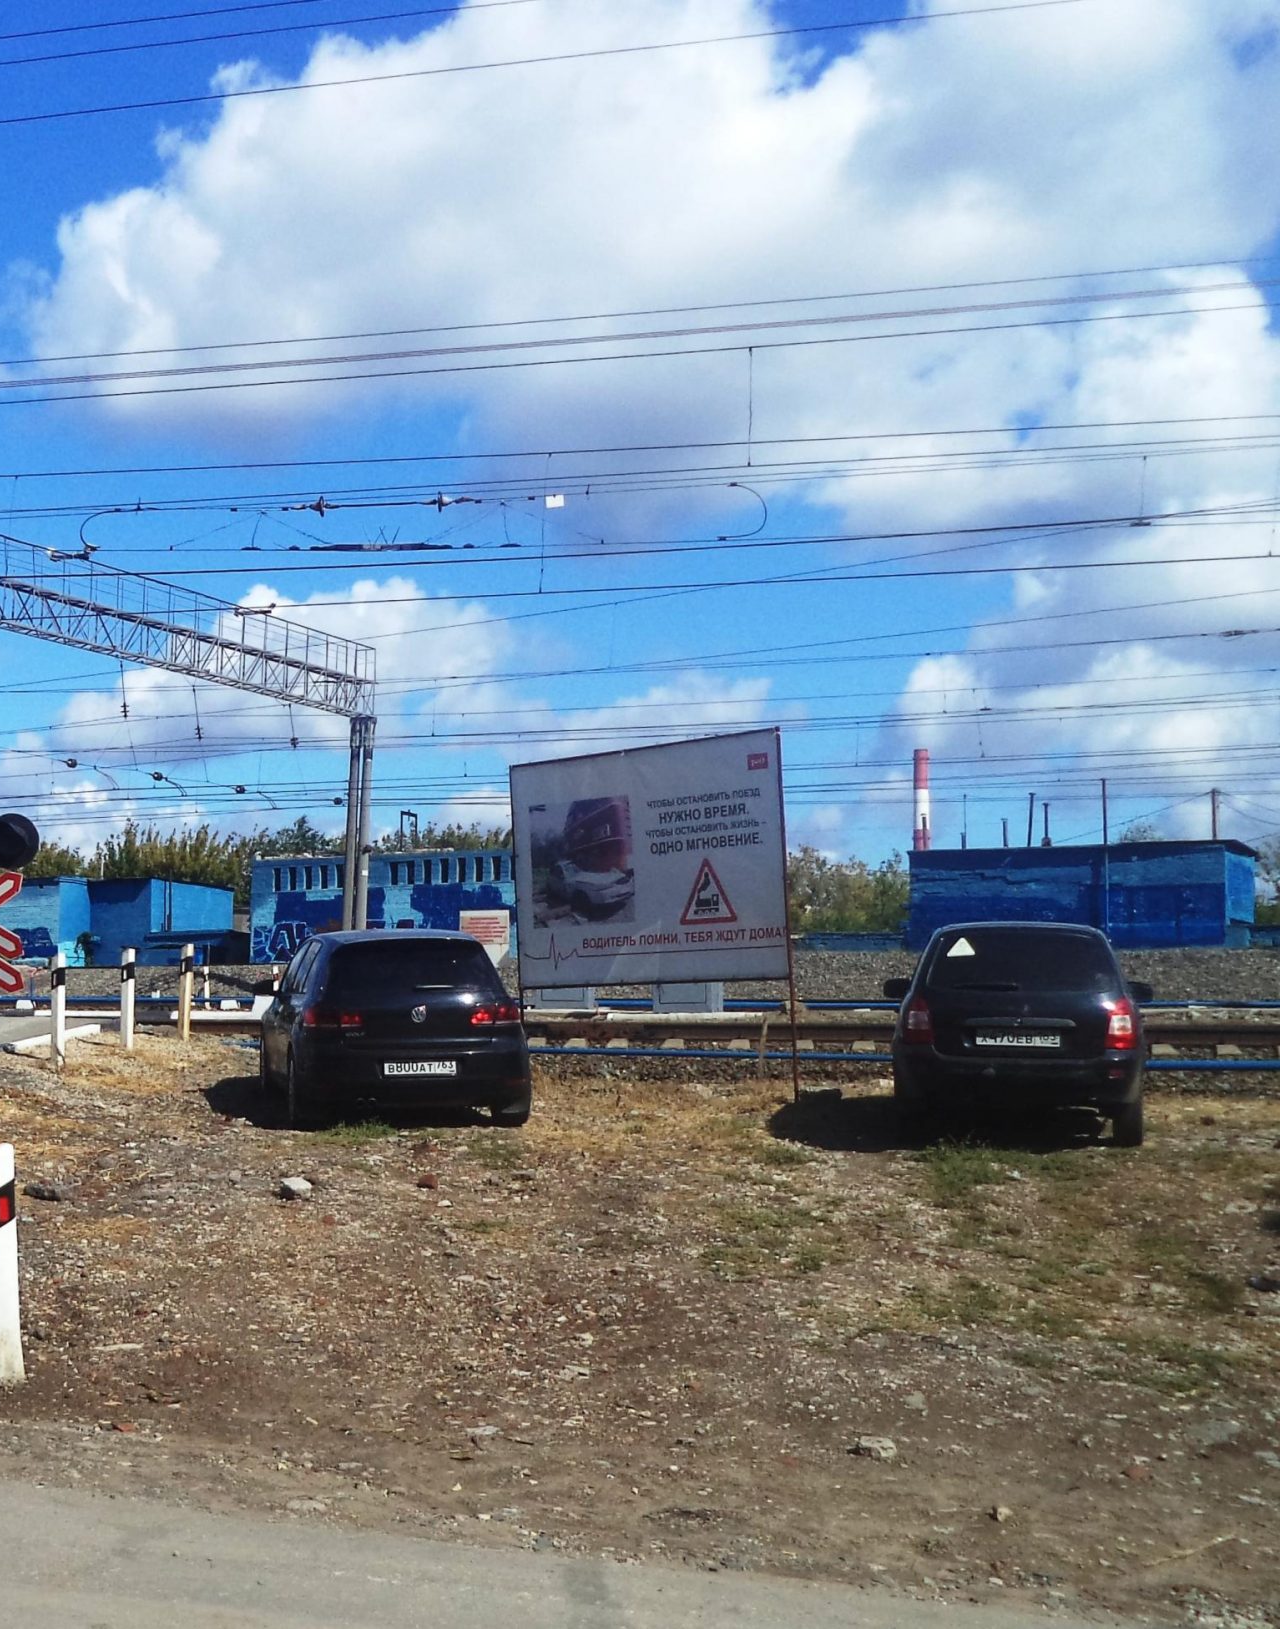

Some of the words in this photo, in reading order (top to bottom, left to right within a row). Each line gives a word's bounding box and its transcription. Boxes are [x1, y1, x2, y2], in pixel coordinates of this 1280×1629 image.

[647, 798, 675, 809] ЧТОБЫ
[676, 791, 730, 806] ОСТАНОВИТЬ
[732, 788, 760, 799] ПОЕЗД
[659, 808, 701, 824] НУЖНО
[704, 803, 750, 820] ВРЕМЯ.
[645, 829, 673, 839] ЧТОБЫ
[675, 822, 729, 836] ОСТАНОВИТЬ
[730, 819, 759, 830] ЖИЗНЬ
[650, 840, 683, 856] ОДНО
[686, 832, 763, 851] МГНОВЕНИЕ.
[582, 935, 636, 950] ВОДИТЕЛЬ
[639, 932, 681, 946] ПОМНИ,
[684, 930, 713, 943] ТЕБЯ
[716, 928, 746, 943] ЖДУТ
